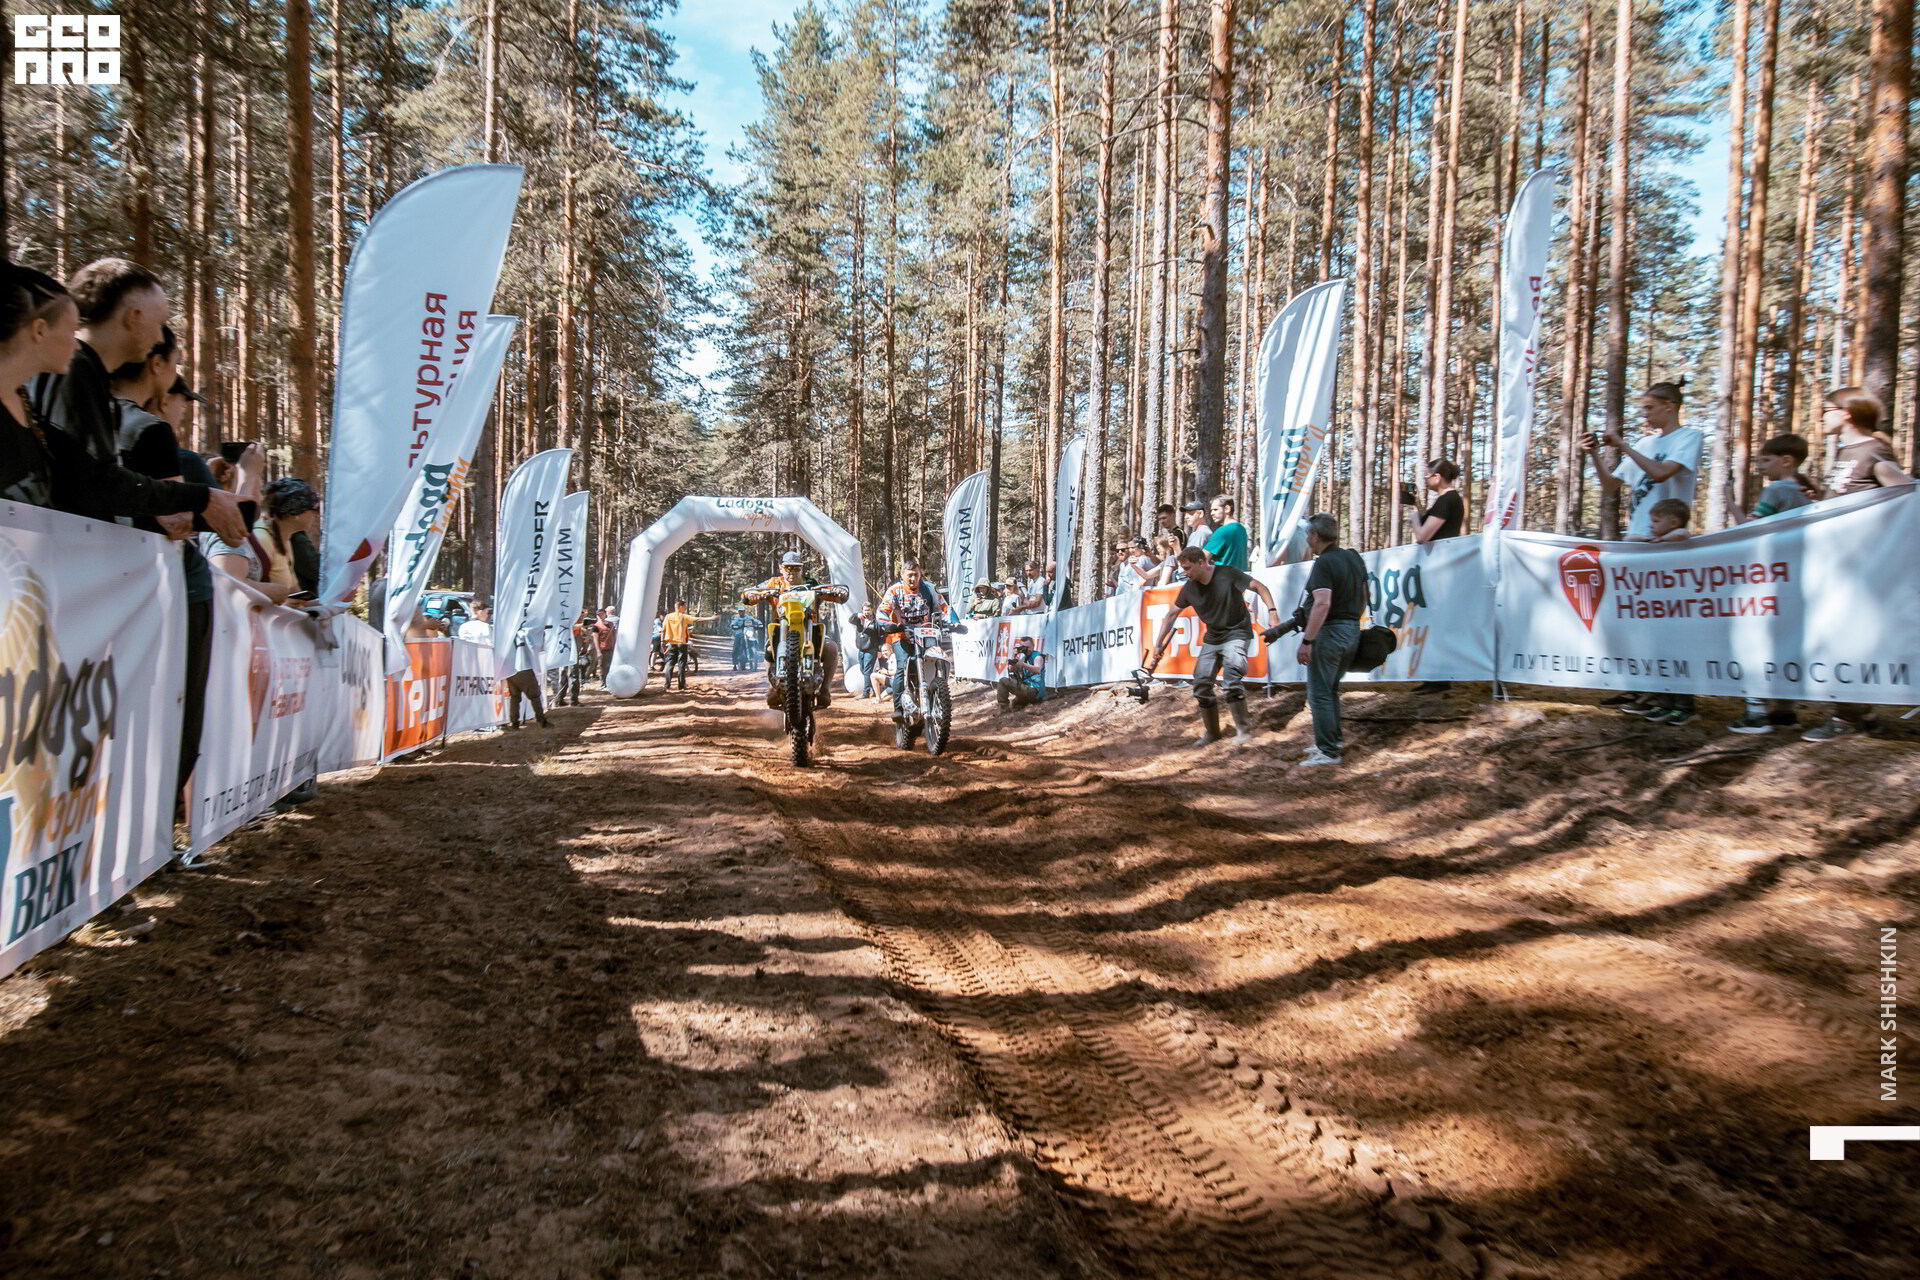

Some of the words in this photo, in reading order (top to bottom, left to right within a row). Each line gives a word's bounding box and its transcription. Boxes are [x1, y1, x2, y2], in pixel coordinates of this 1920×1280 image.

[1611, 561, 1790, 595] Культурная
[1616, 595, 1780, 619] Навигация
[1062, 625, 1134, 657] PATHFINDER
[1512, 653, 1690, 679] ПУТЕШЕСТВУЕМ
[1706, 661, 1745, 680] ПО
[1763, 661, 1911, 685] РОССИИ
